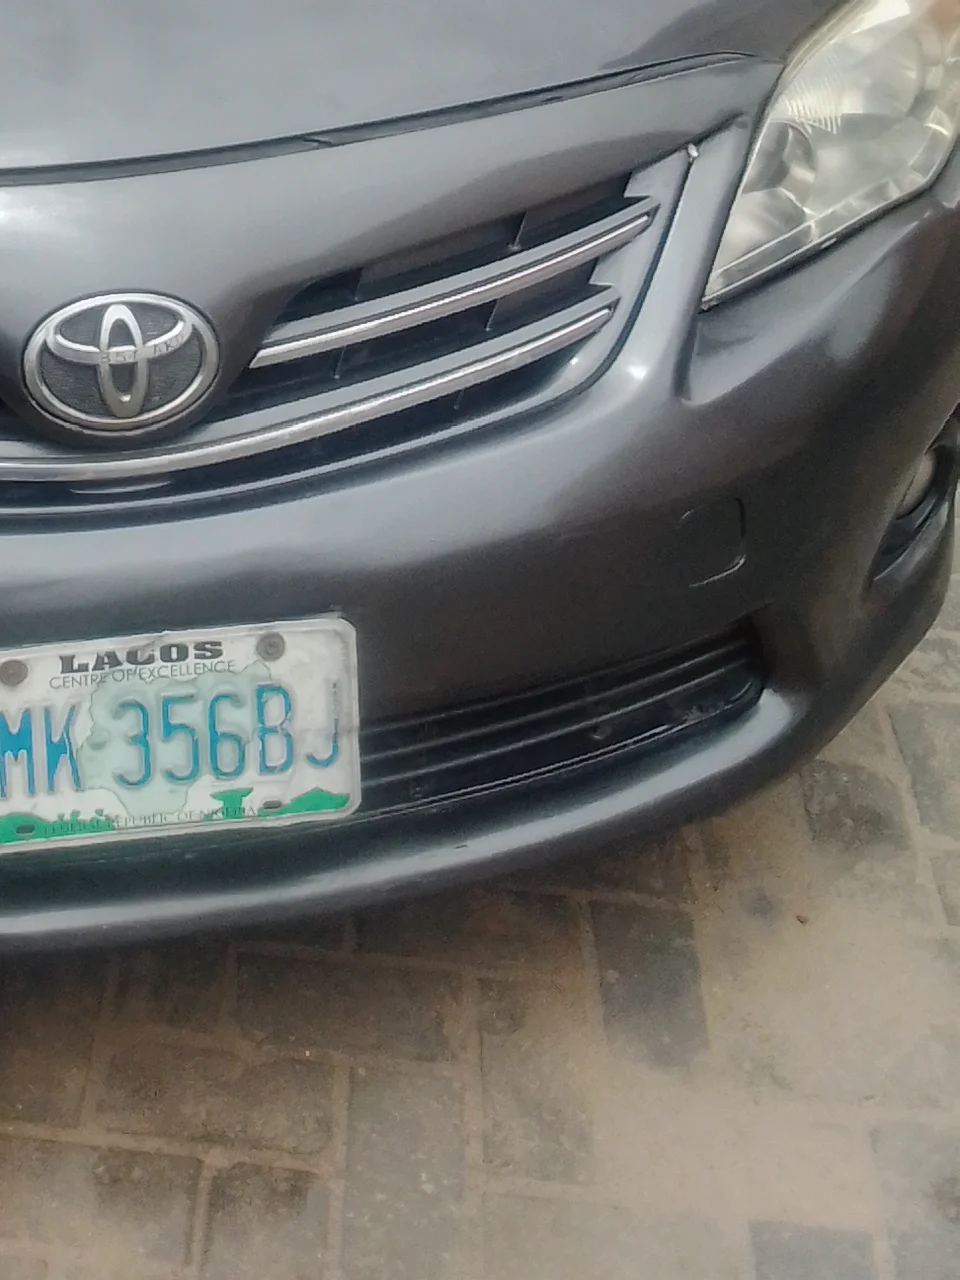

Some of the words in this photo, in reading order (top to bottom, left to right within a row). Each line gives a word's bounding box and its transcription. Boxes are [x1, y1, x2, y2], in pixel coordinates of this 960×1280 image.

[49, 672, 107, 690] CENTRE
[111, 667, 136, 683] OF
[139, 659, 237, 680] EXCELLENCE
